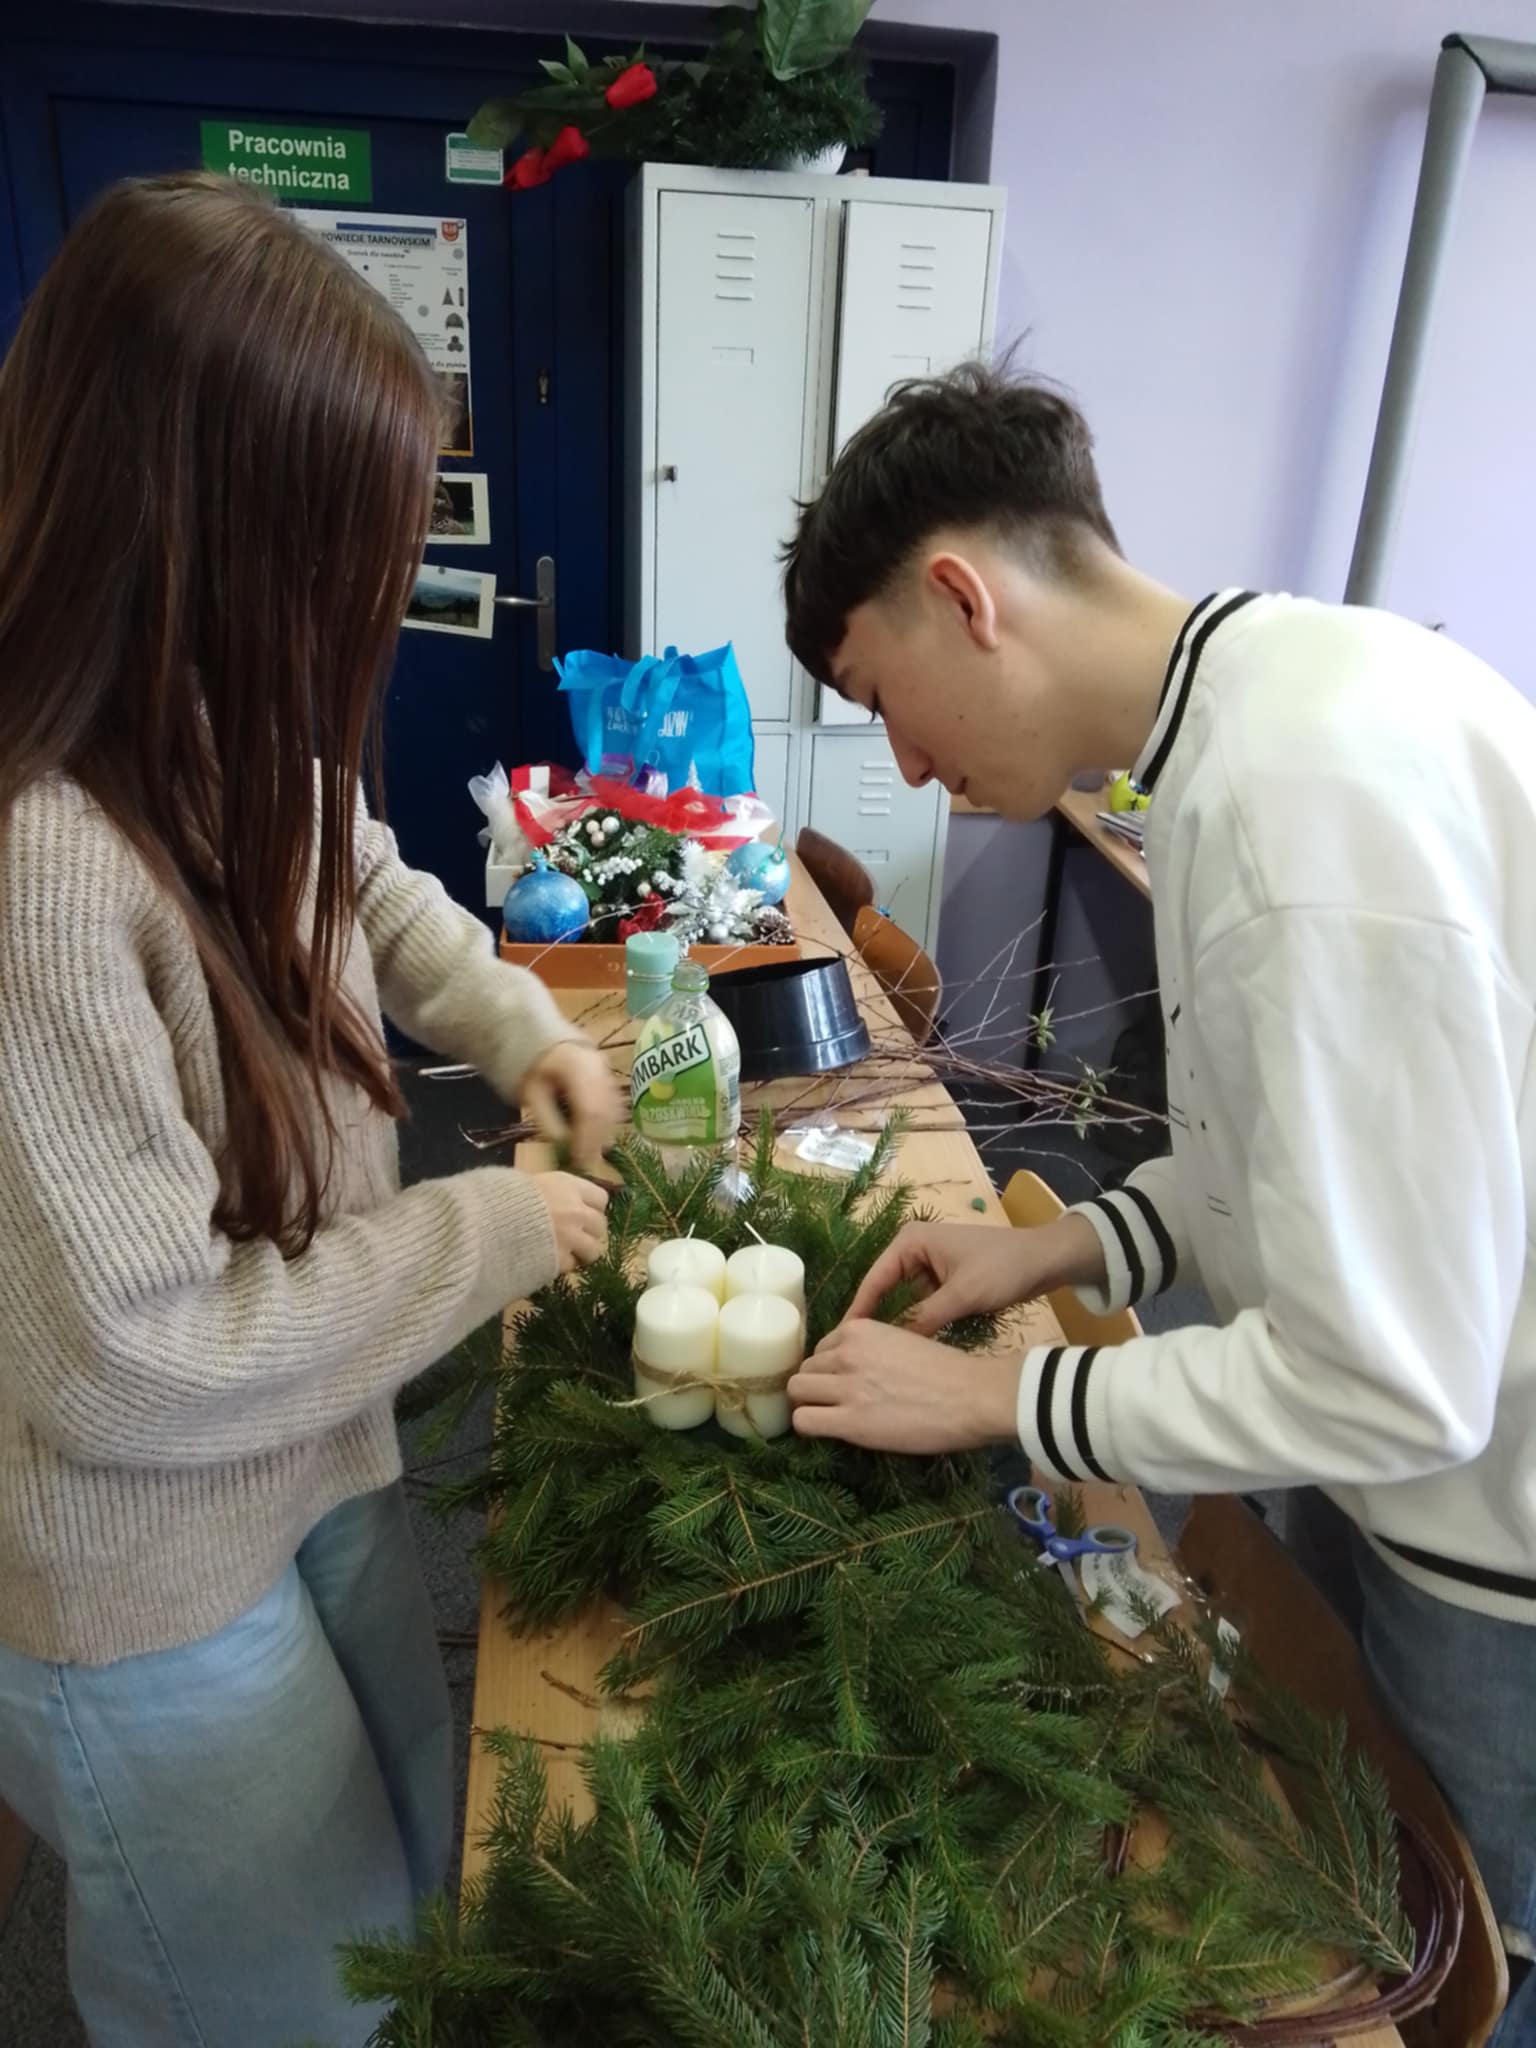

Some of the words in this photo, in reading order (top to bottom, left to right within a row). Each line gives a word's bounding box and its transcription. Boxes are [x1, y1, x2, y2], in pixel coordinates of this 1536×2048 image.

[228, 129, 346, 159] Pracownia
[228, 162, 350, 190] techniczna
[367, 235, 431, 247] TARNOWSKIM
